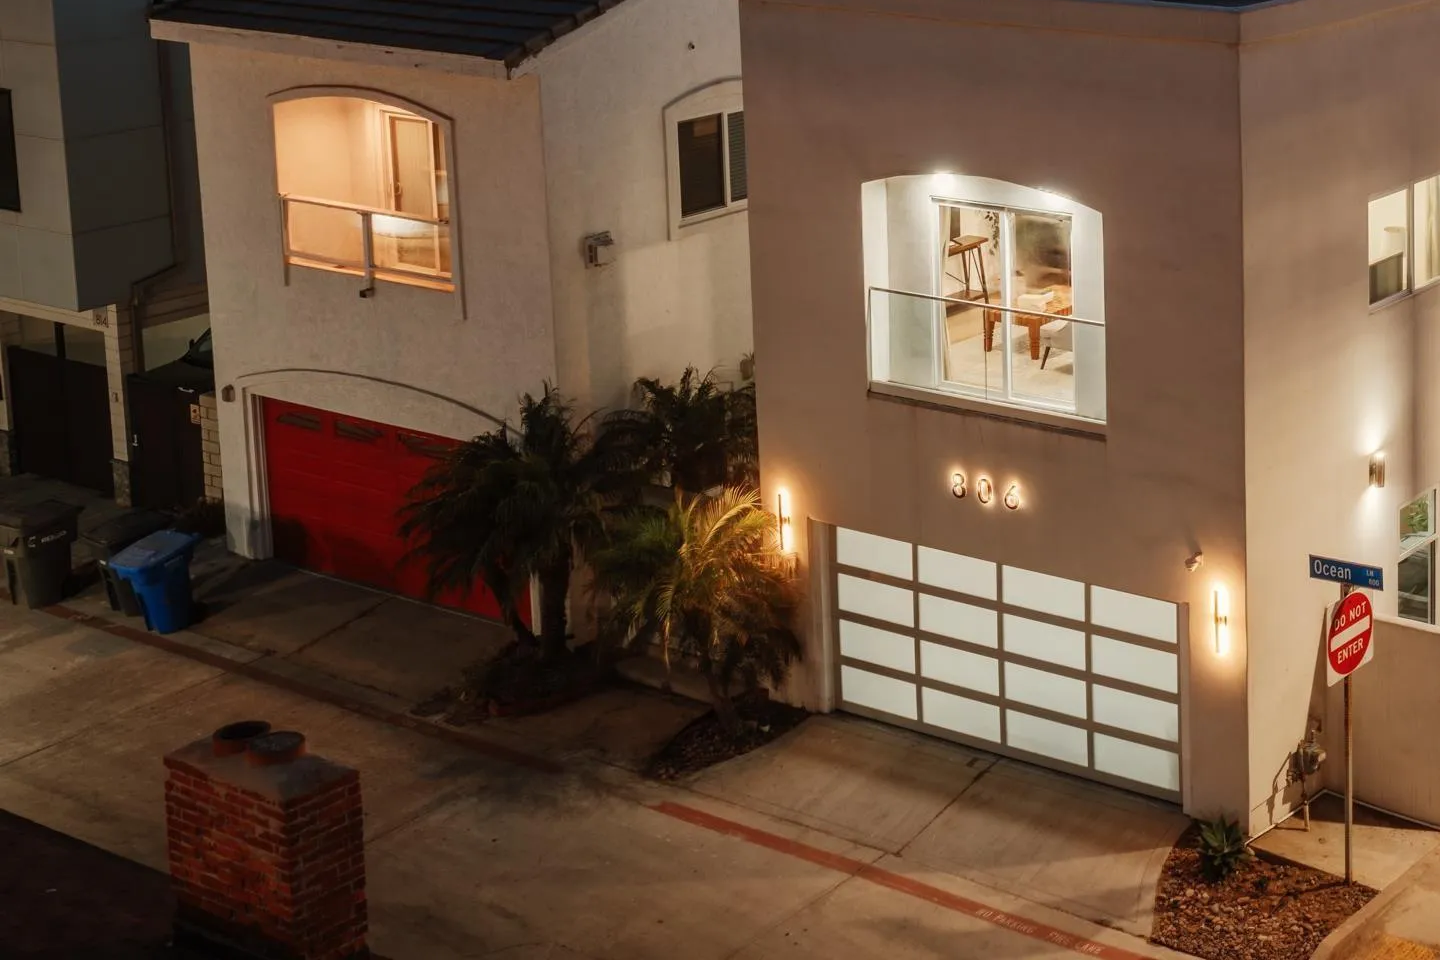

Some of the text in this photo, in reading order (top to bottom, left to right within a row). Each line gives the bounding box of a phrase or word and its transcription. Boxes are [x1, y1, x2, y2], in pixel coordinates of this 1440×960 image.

[952, 473, 1020, 510] 806
[1314, 559, 1352, 580] Ocean
[1333, 601, 1367, 632] DO NOT
[1337, 638, 1364, 664] ENTER
